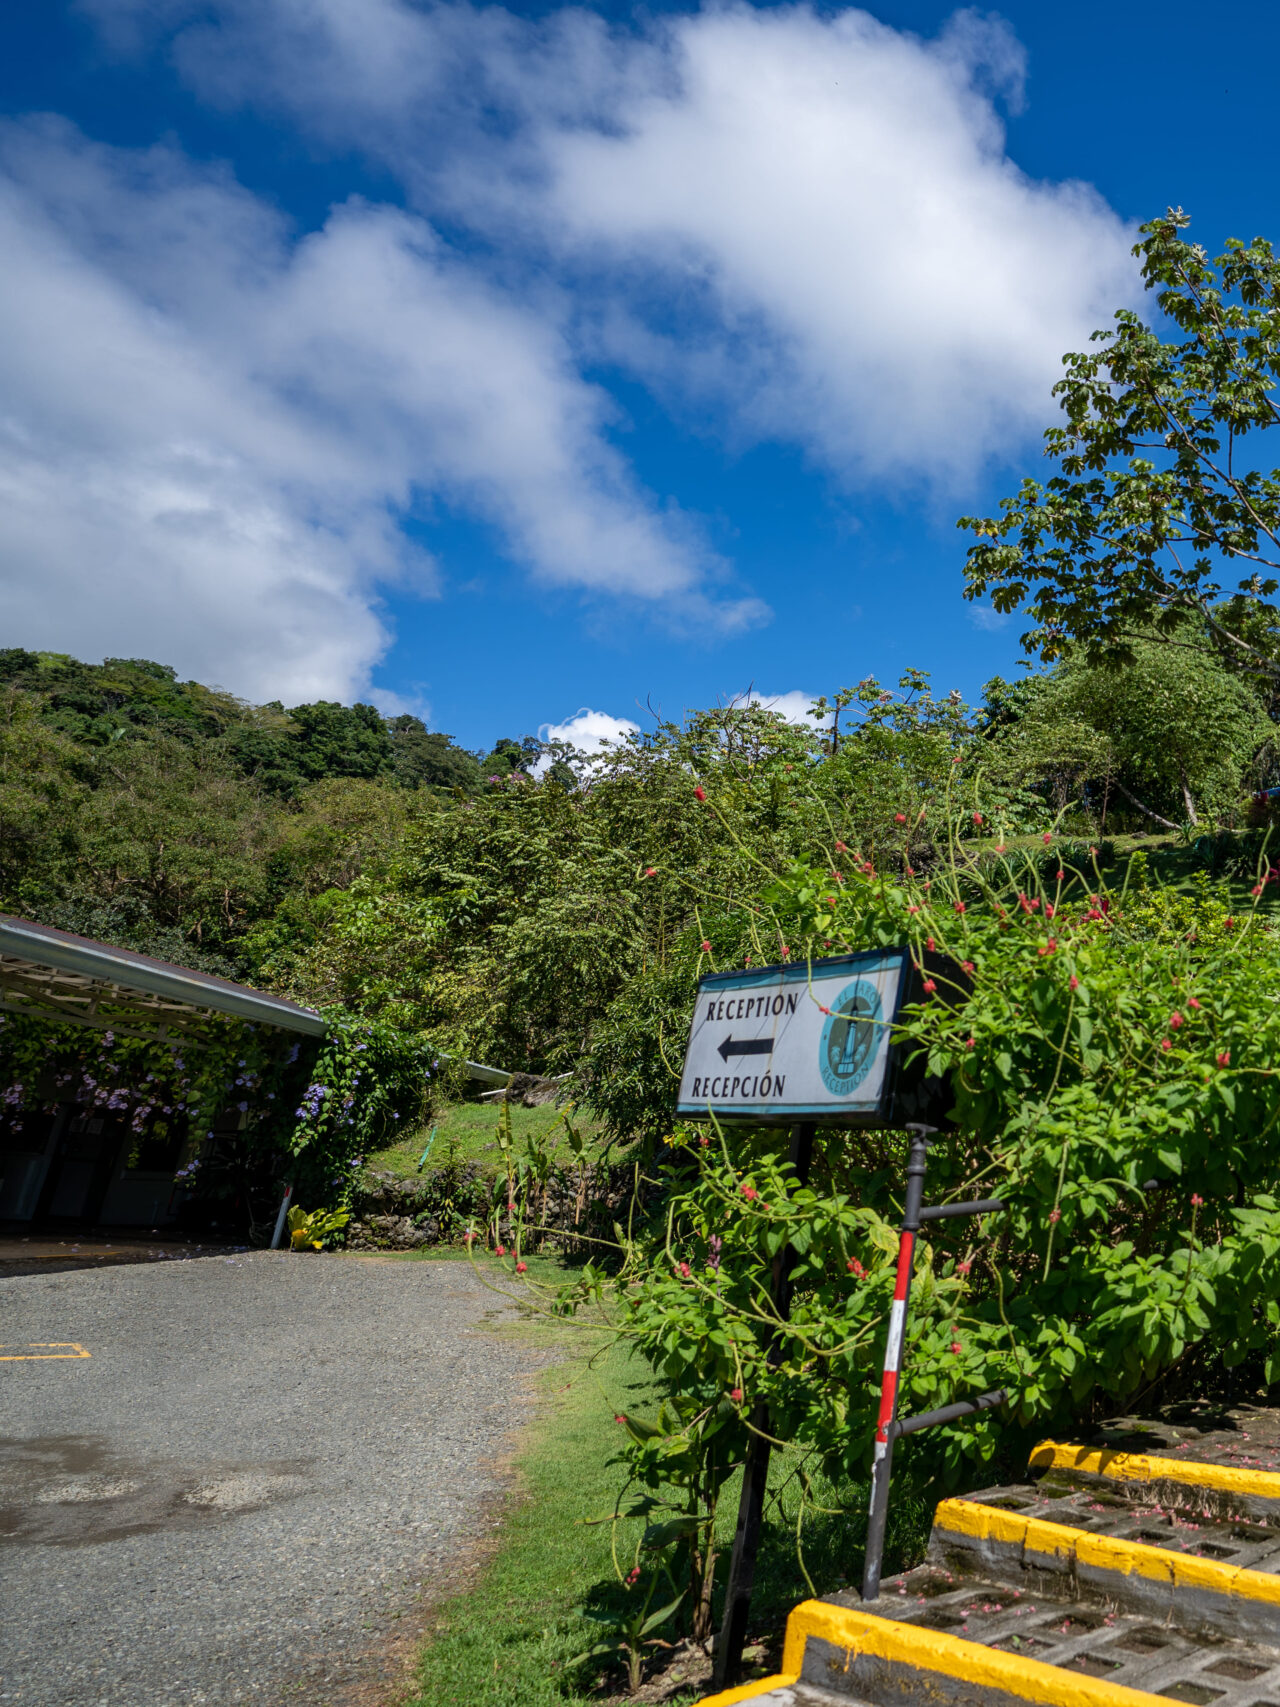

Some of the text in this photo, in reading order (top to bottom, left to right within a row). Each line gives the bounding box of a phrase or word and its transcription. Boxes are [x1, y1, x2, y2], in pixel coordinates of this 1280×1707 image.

[705, 992, 799, 1021] RECEPTION
[854, 983, 878, 1004] ARO
[691, 1069, 786, 1098] RECEPCIÓN
[822, 1064, 869, 1094] RECEPTION
